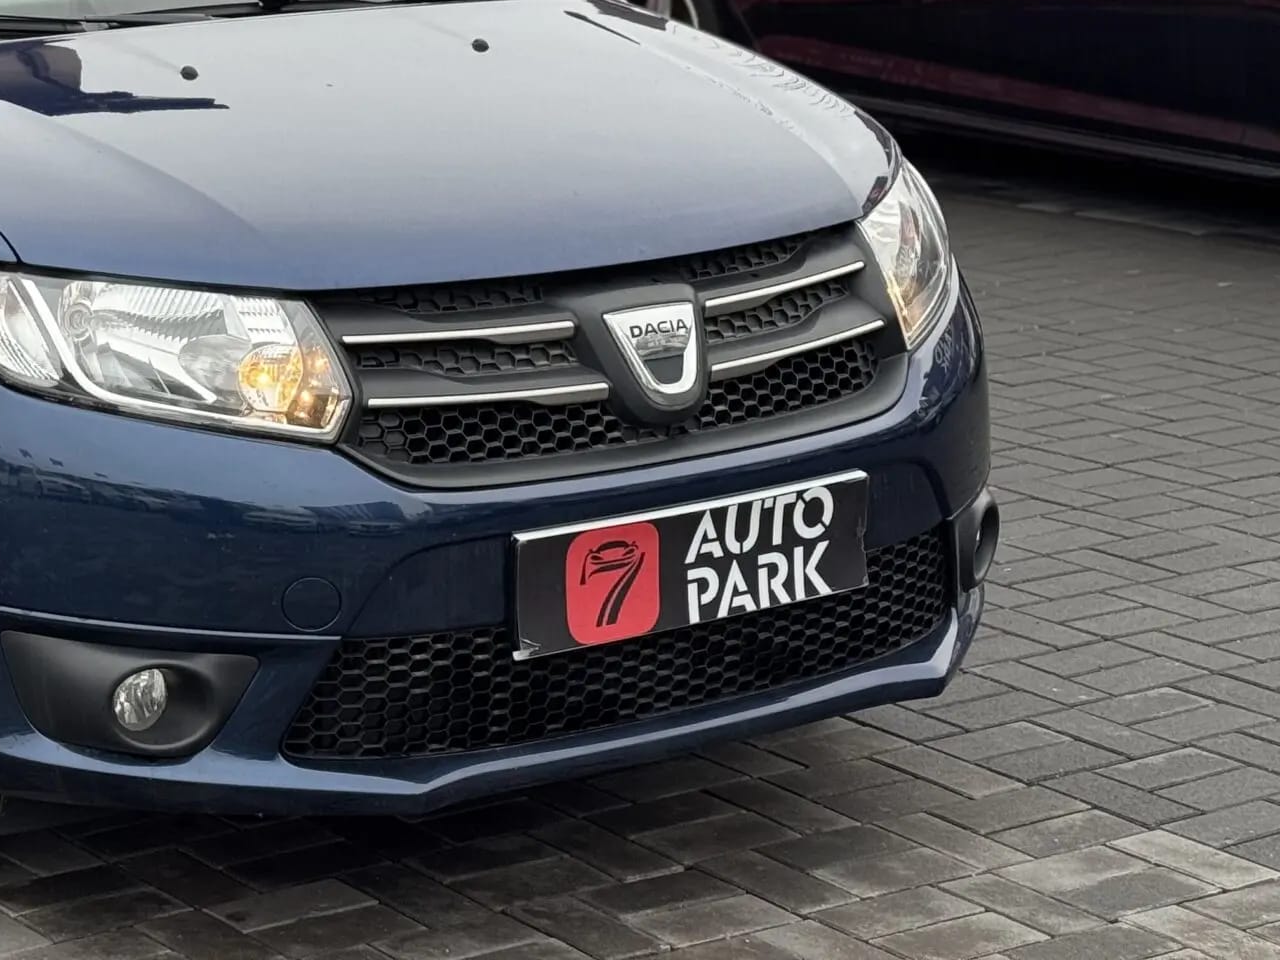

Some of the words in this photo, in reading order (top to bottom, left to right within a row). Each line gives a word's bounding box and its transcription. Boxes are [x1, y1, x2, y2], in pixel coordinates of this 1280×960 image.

[629, 318, 689, 339] DACIA
[684, 486, 835, 565] AUTO
[685, 540, 834, 625] PARK
